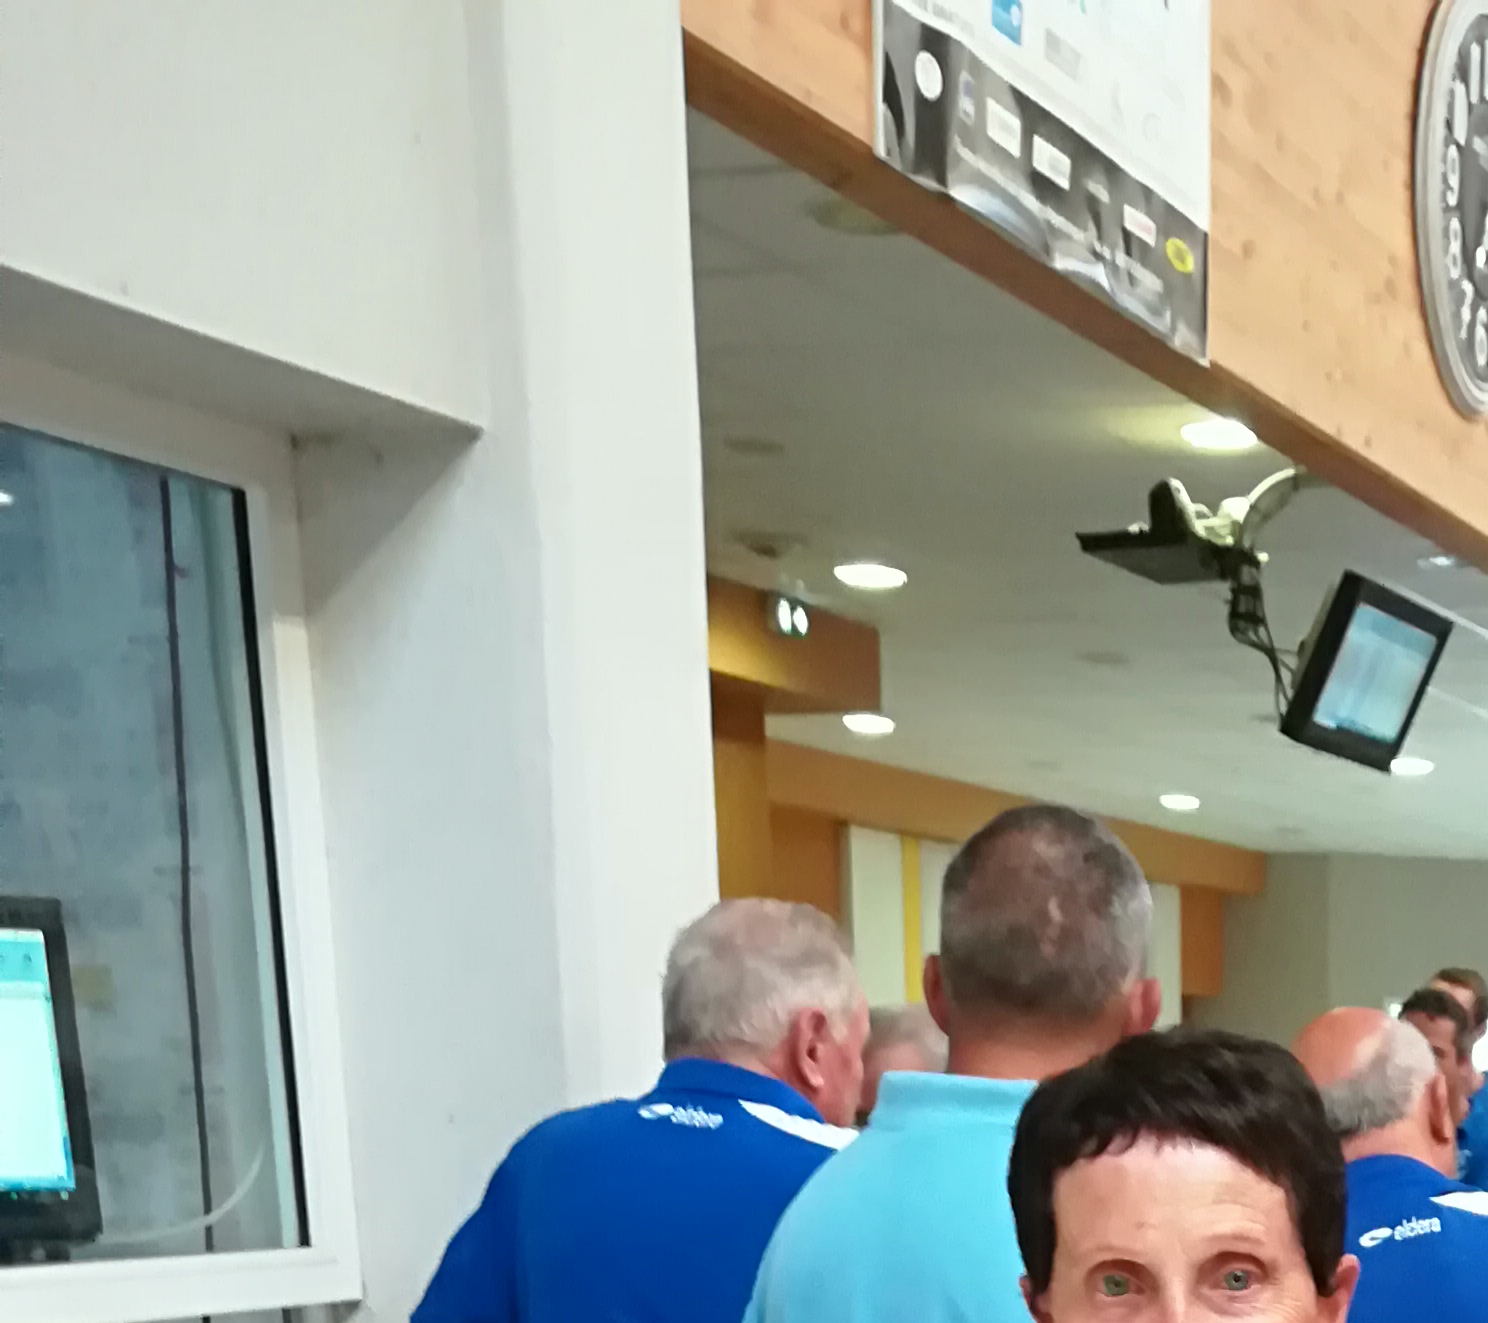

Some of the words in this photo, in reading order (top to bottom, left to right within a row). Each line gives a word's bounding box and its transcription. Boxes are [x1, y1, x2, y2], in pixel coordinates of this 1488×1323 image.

[1446, 143, 1460, 207] 9
[1447, 216, 1462, 279] 8
[1475, 305, 1488, 367] 6
